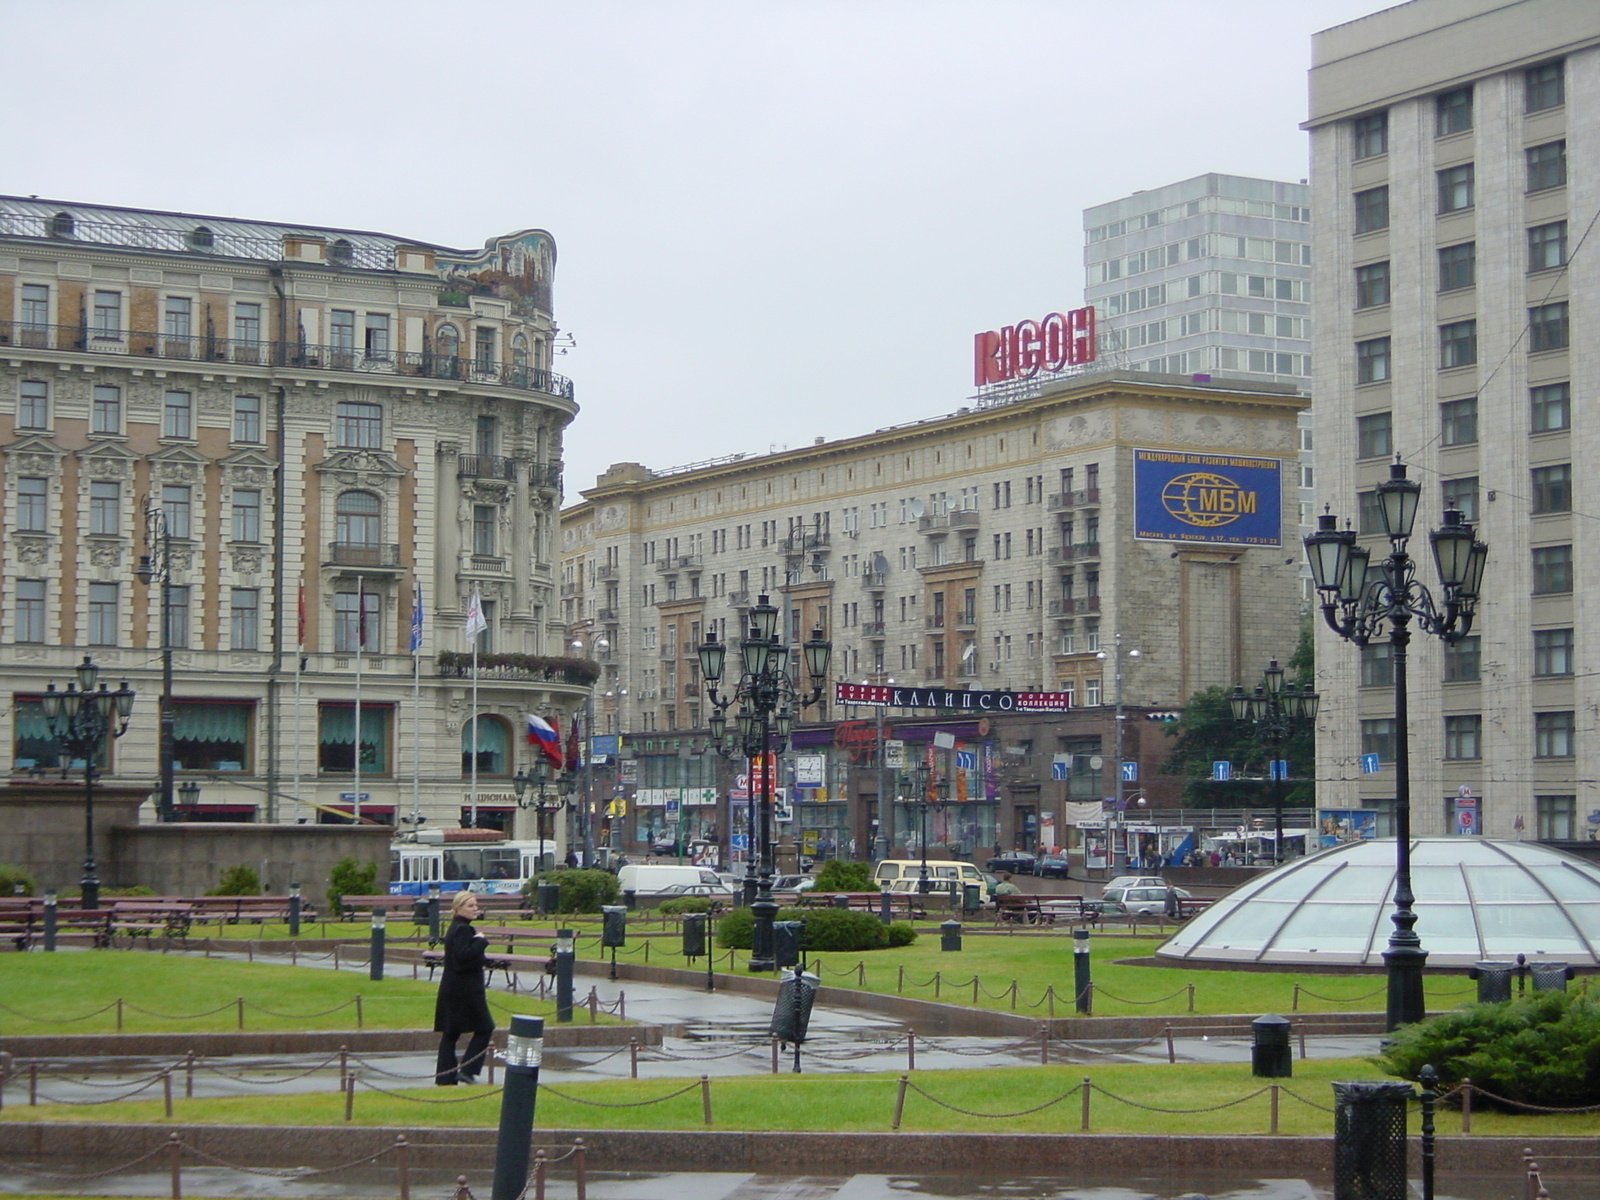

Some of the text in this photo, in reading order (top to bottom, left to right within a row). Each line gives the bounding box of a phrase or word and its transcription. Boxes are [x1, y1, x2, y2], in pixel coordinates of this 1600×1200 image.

[974, 306, 1095, 387] RICOH
[1139, 452, 1185, 464] МЕЖДУНАРОДНЫЙ
[1200, 488, 1256, 514] МБМ
[838, 685, 888, 694] НОВЫЙ
[838, 692, 887, 701] БУТИК
[894, 690, 1012, 710] КАЛИПСО
[632, 737, 711, 752] АПТЕКА
[1461, 827, 1472, 835] LG
